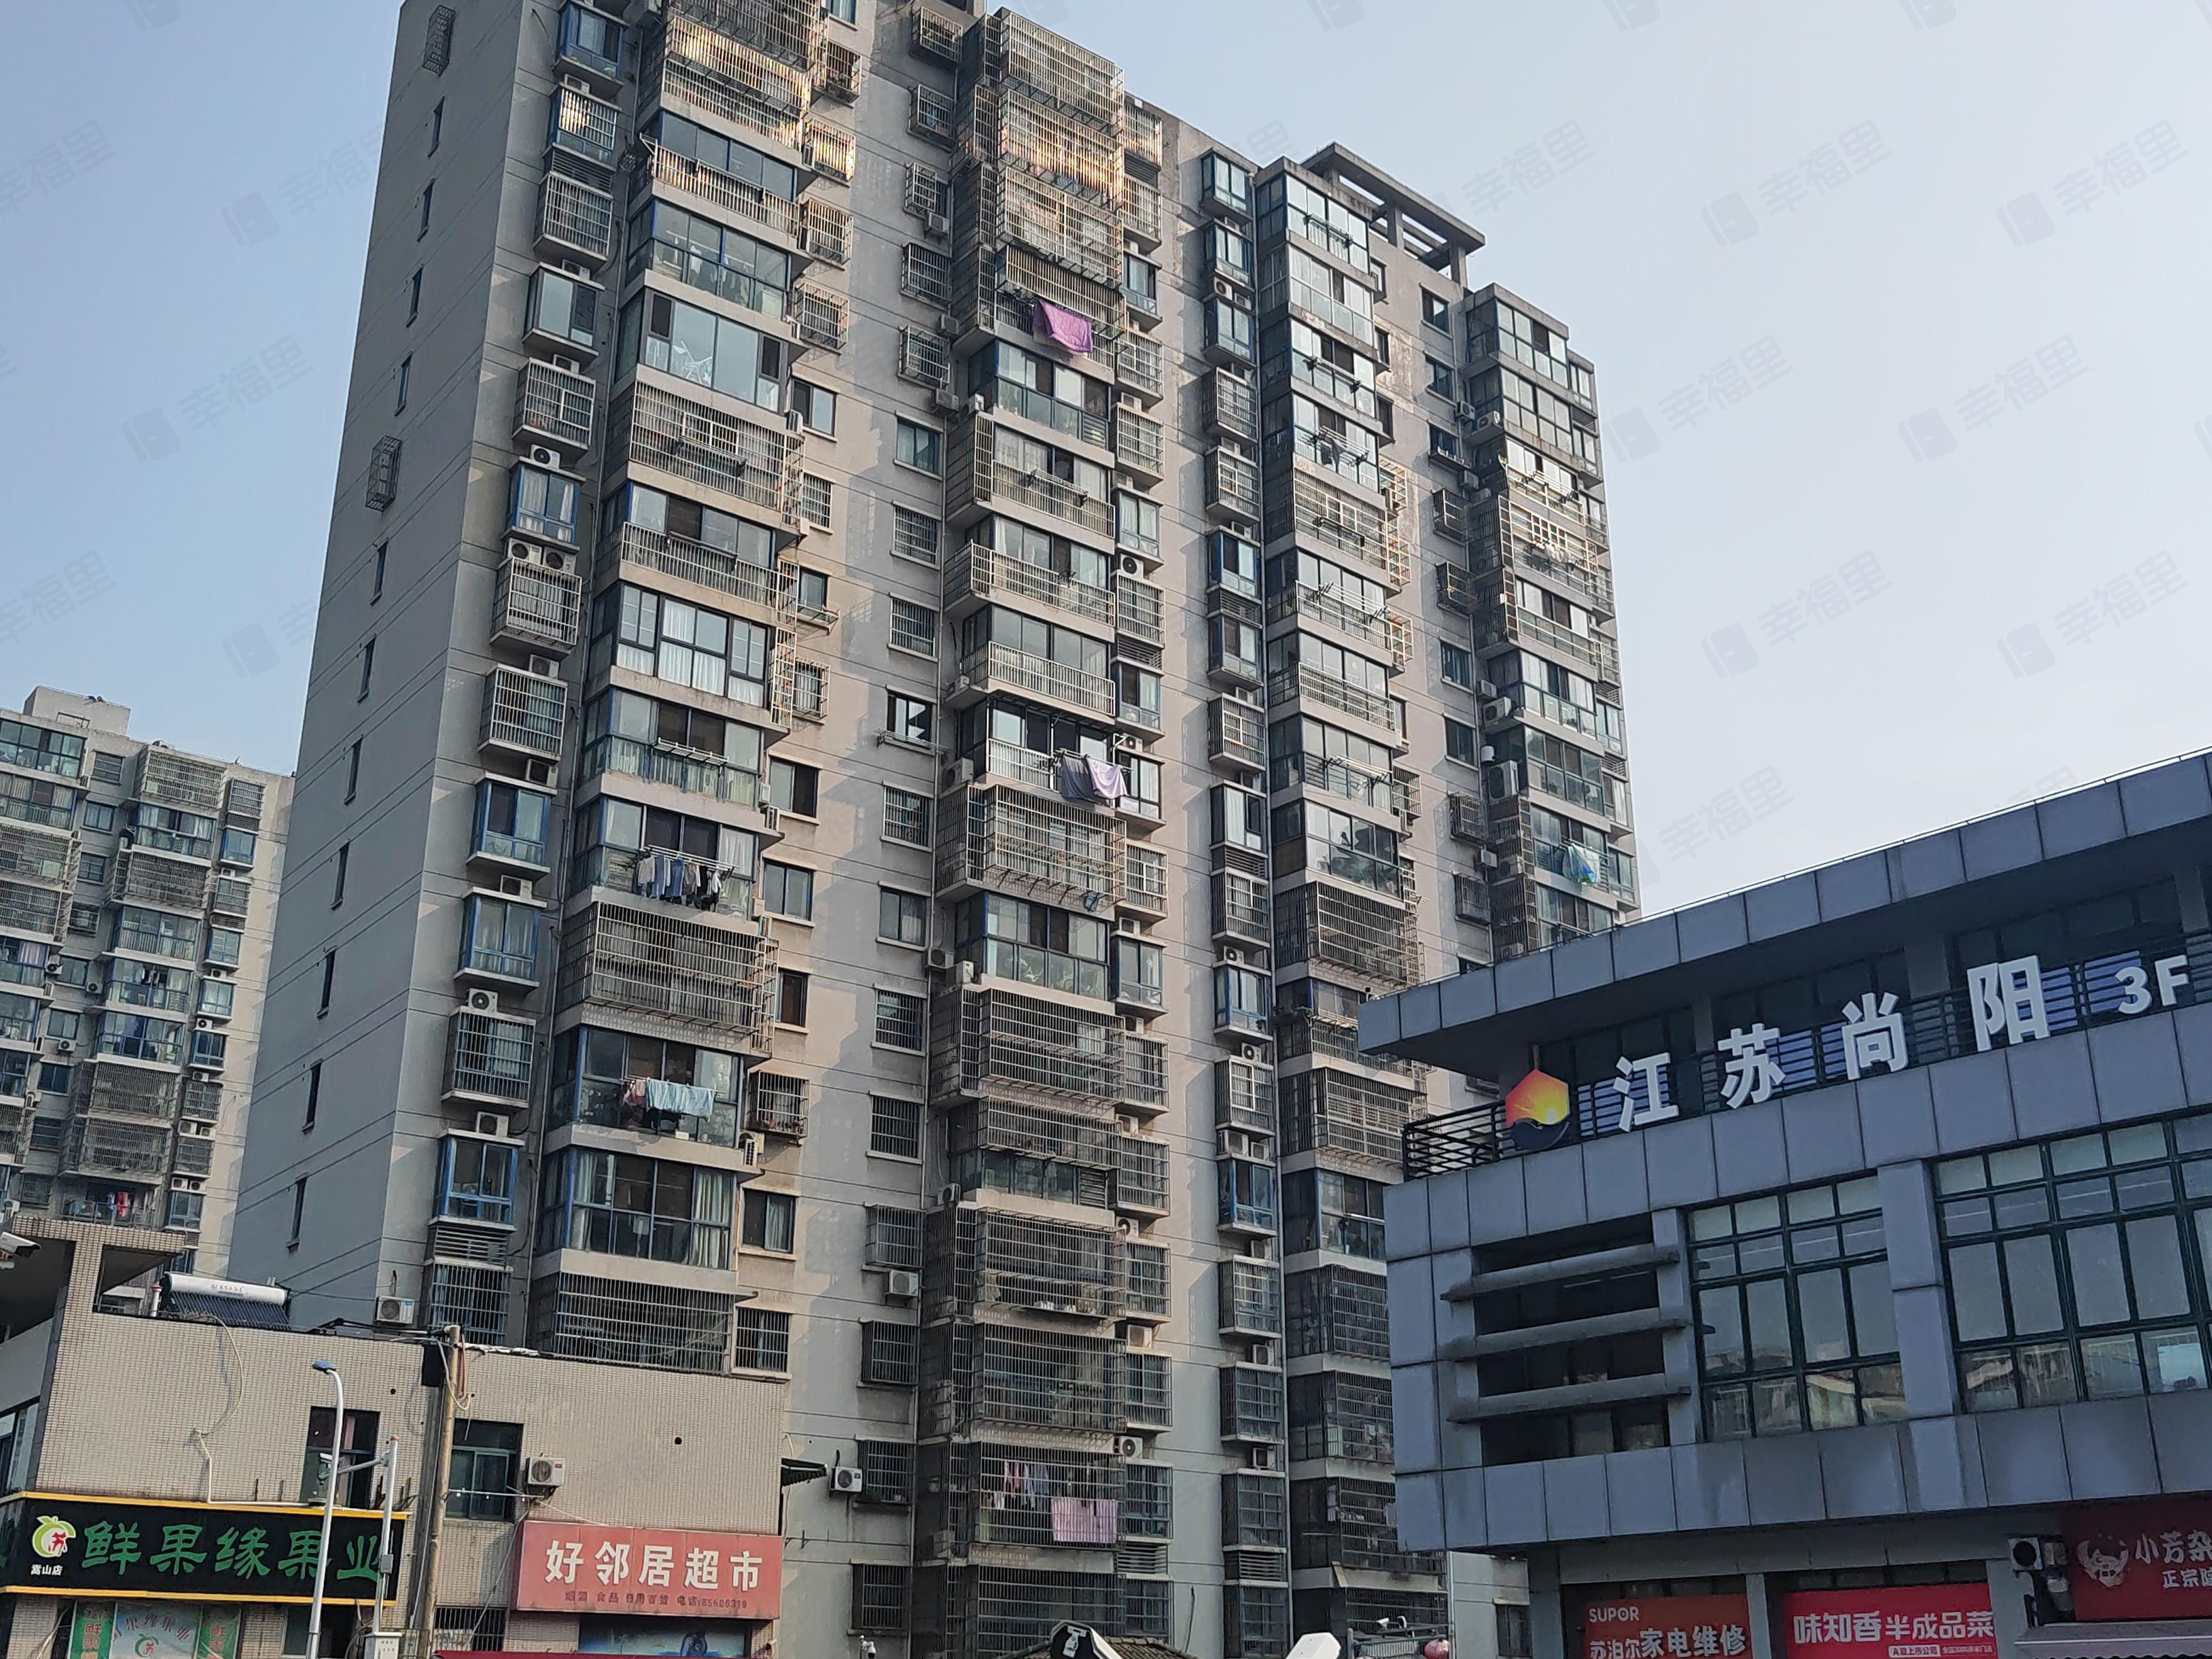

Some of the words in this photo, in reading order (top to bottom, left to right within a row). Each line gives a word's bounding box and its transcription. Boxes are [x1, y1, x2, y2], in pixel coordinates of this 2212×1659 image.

[1613, 955, 2050, 1132] 江苏尚阳
[2115, 955, 2189, 1015] 3F
[82, 1521, 380, 1582] 鲜果缘果业
[544, 1540, 763, 1592] 好邻居超市
[31, 1564, 63, 1576] 嵩山店
[597, 1591, 619, 1603] 食品
[626, 1593, 669, 1606] 日用百货
[1589, 1606, 1640, 1622] SUPOR
